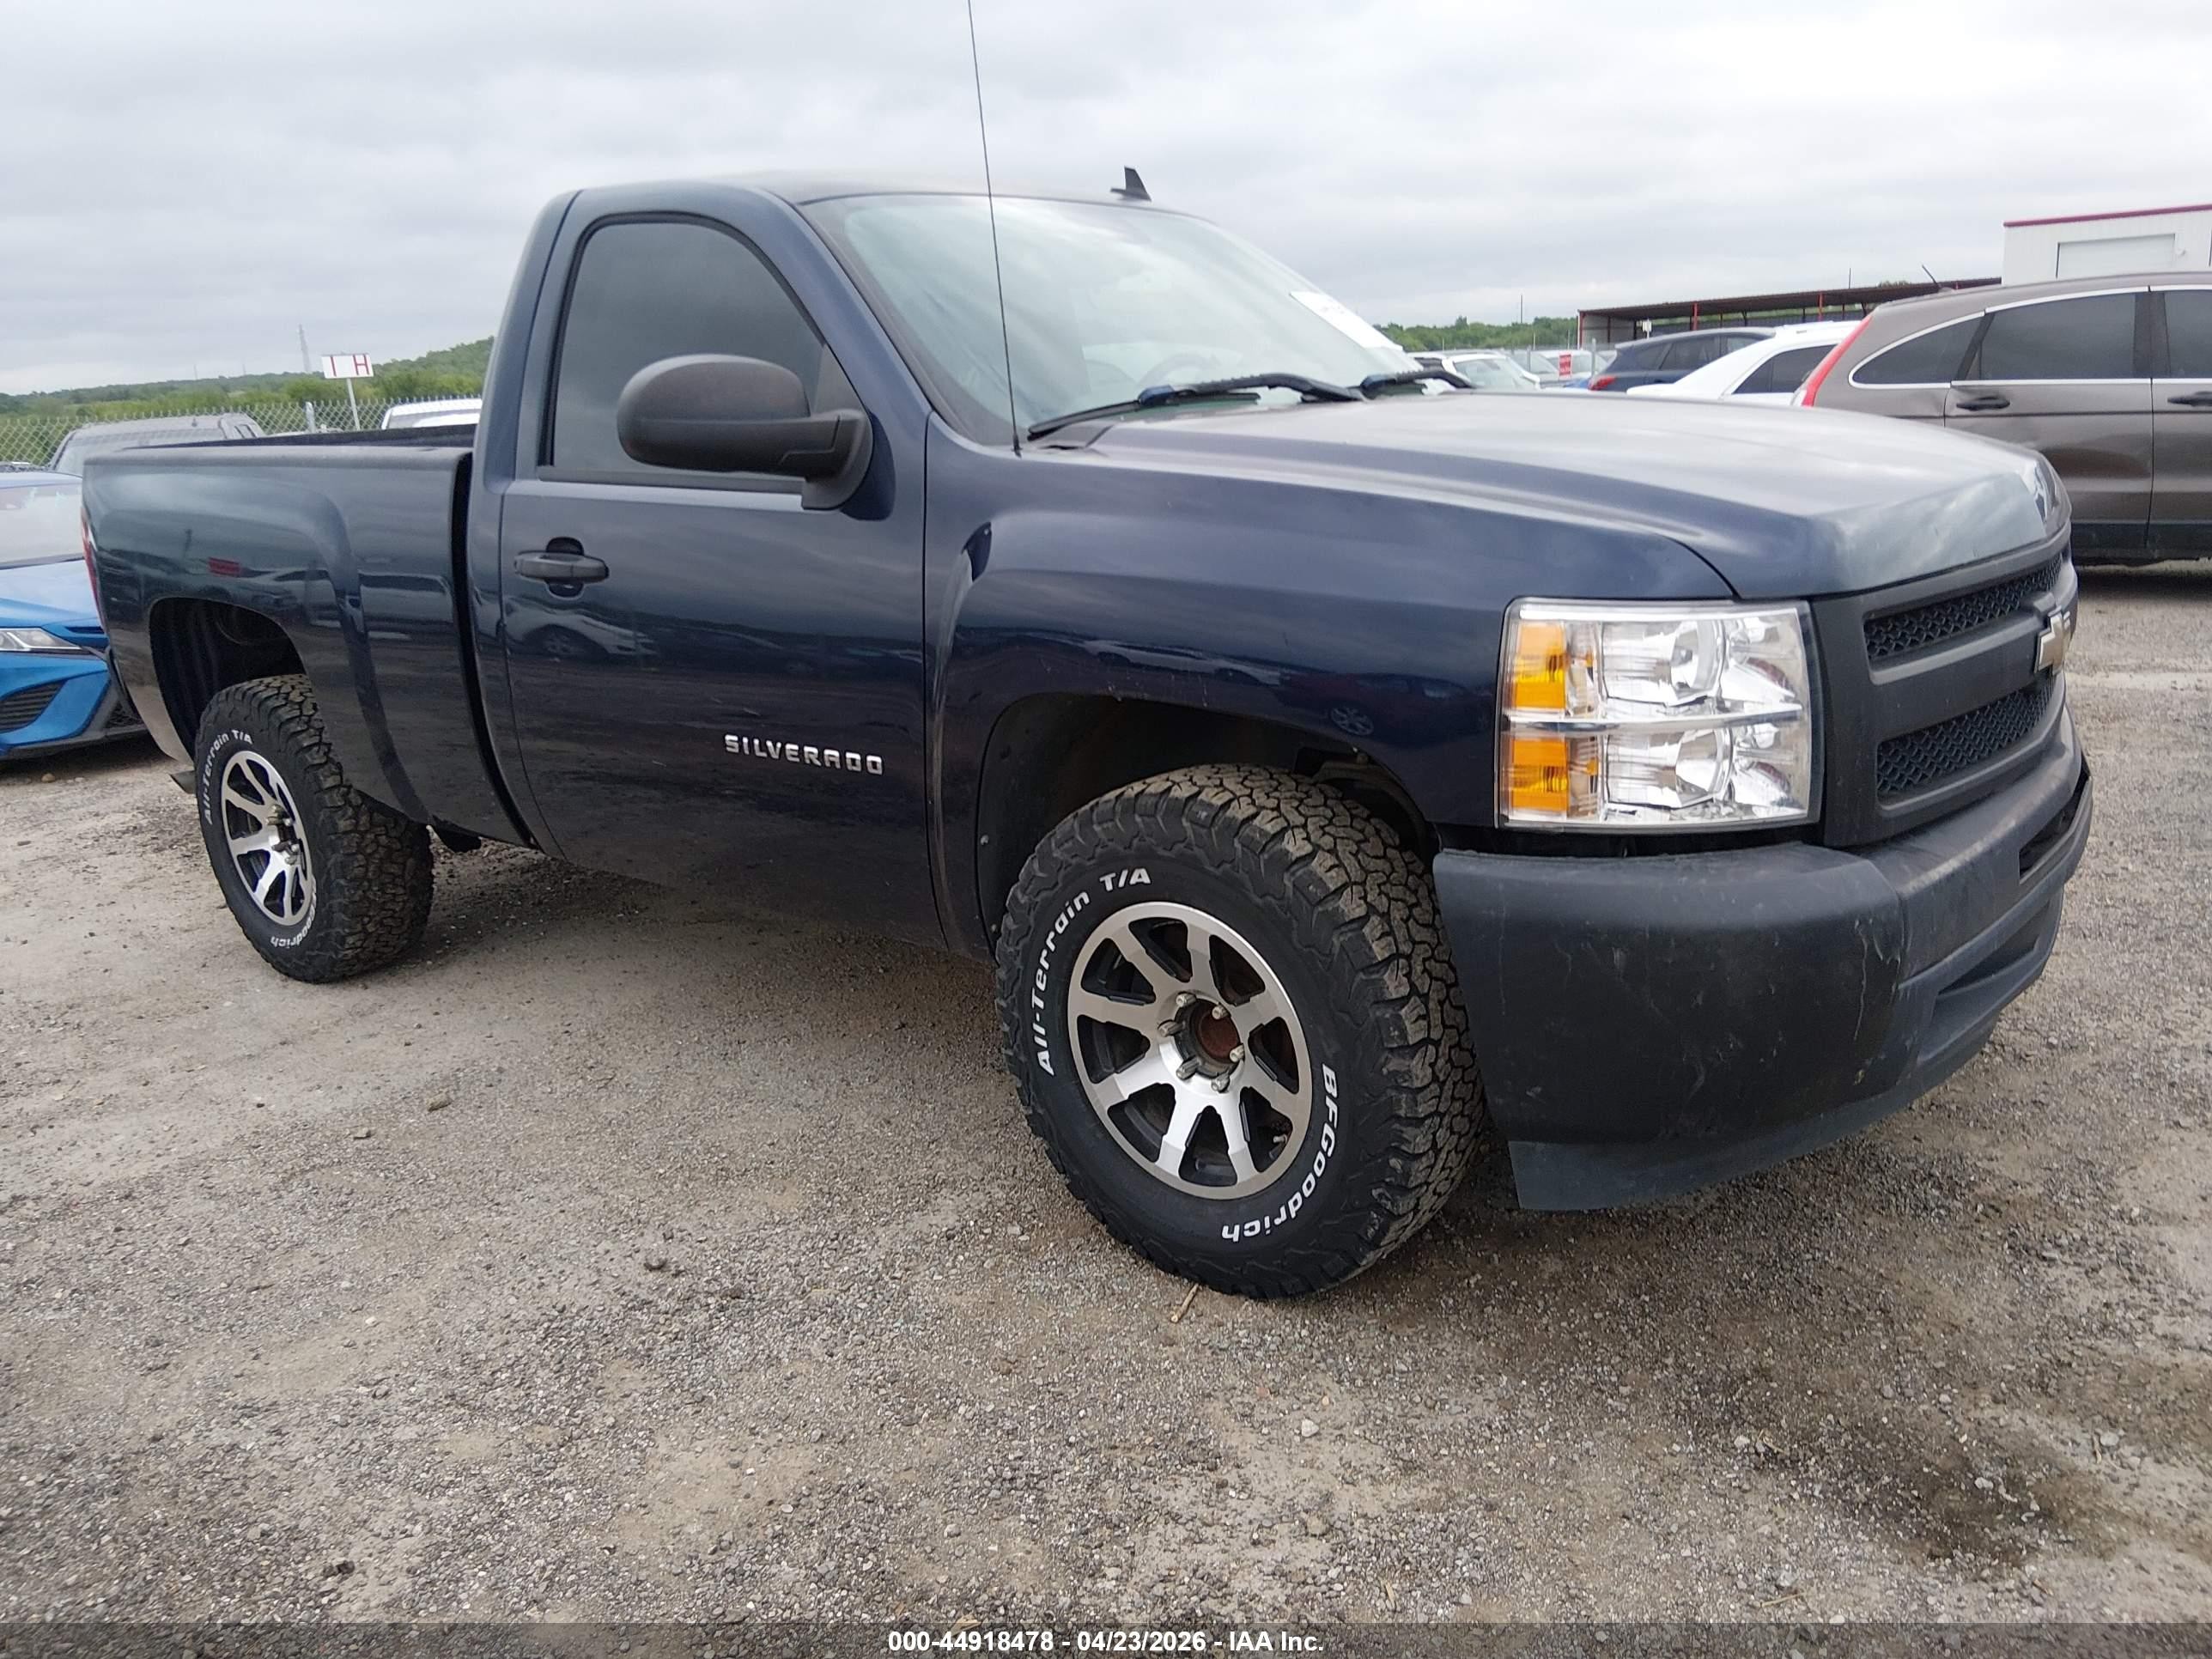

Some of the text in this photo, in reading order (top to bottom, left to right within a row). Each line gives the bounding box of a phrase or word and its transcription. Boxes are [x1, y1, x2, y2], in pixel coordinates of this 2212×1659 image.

[352, 353, 370, 376] H
[203, 732, 230, 825] All-Terrain
[724, 734, 884, 775] SILVERADO
[1032, 867, 1152, 1075] All-Terrain T/A
[1221, 1063, 1338, 1243] BFGoodrich
